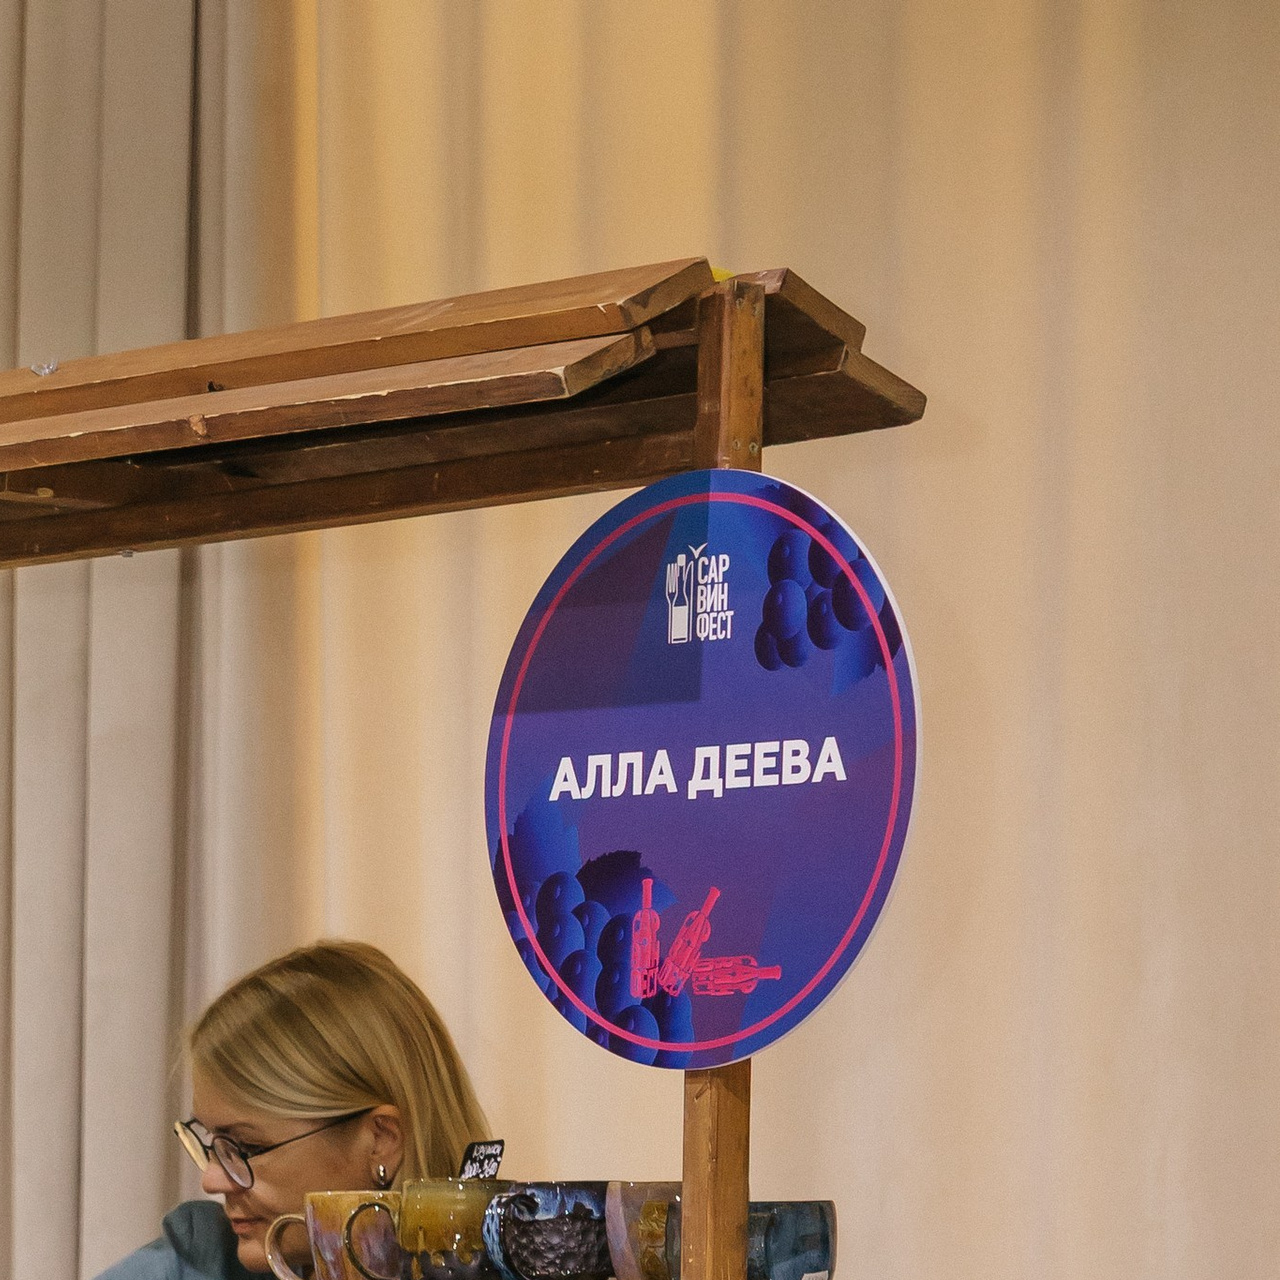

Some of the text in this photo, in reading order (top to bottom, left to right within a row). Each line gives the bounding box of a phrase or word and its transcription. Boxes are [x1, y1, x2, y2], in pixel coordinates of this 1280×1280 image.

[698, 554, 730, 584] САР
[697, 583, 728, 613] ВИН
[696, 611, 734, 641] ФЕСТ
[549, 736, 847, 801] АЛЛА ДЕЕВА
